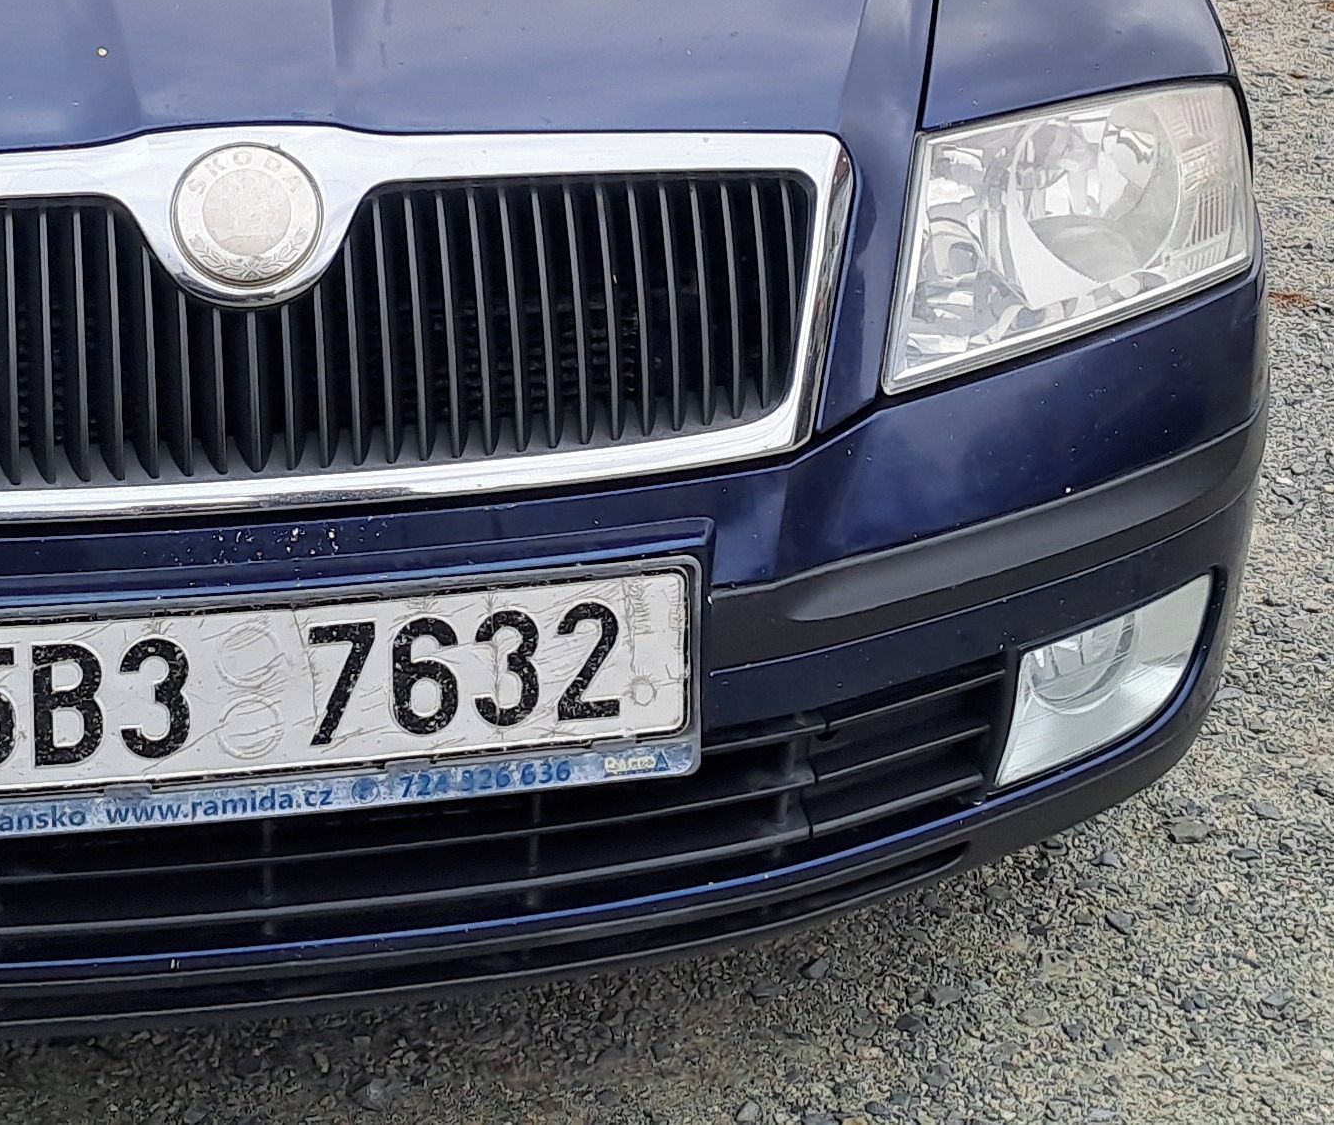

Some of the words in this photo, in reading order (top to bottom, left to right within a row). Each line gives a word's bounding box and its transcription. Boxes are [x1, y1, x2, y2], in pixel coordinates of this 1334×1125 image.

[308, 602, 621, 746] 7632
[105, 787, 334, 824] www.ramida.cz
[520, 759, 572, 786] 636
